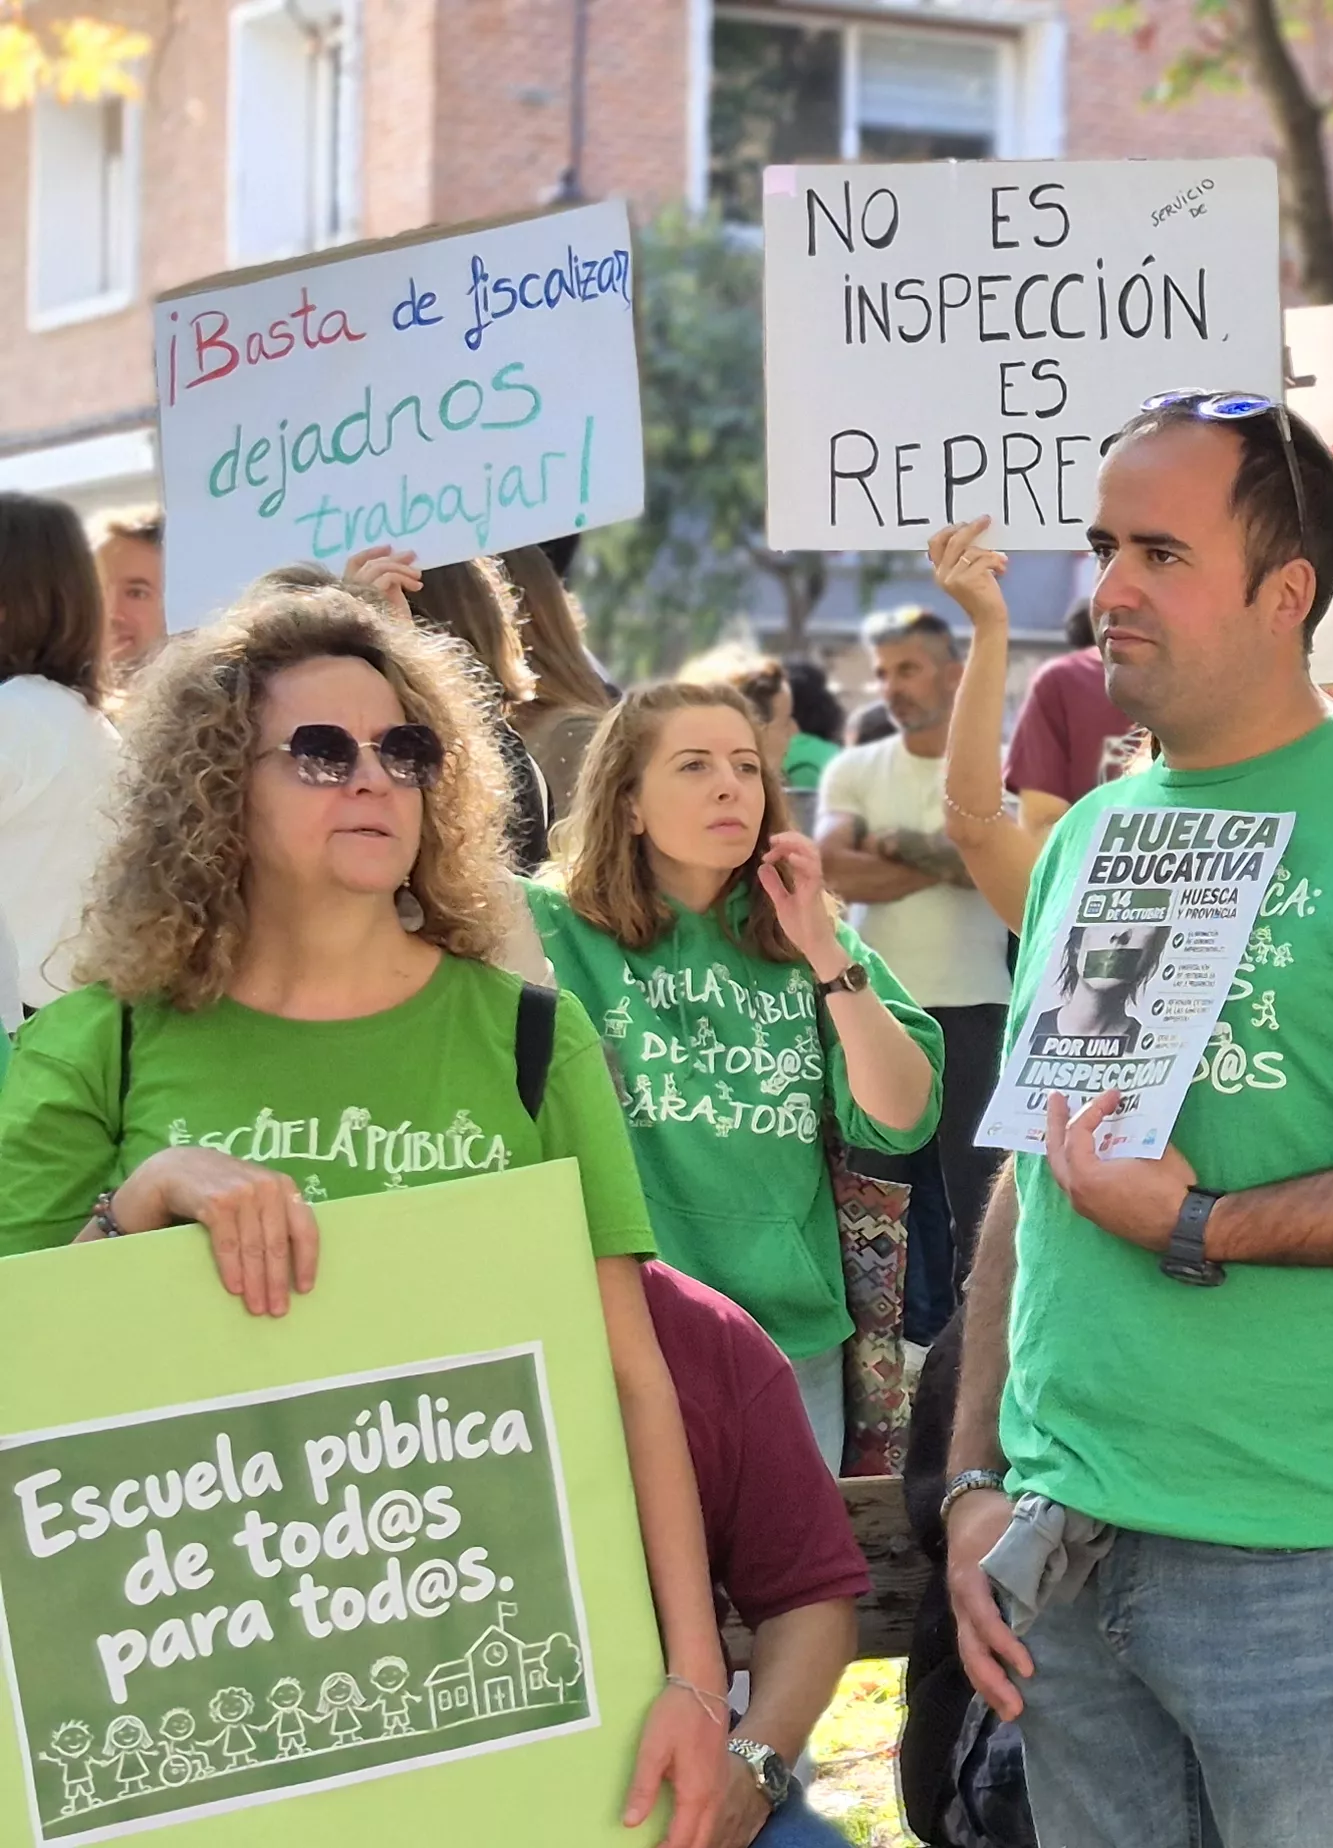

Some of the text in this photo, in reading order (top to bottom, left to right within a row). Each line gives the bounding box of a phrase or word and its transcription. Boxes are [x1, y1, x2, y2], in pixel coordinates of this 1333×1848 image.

[805, 180, 1071, 257] NO ES
[1150, 178, 1215, 228] SERVICIO
[168, 244, 631, 408] ¡Basta de fiscalizar
[999, 356, 1068, 420] ES
[208, 360, 544, 519] dejadnos
[829, 428, 1118, 528] REPRE
[1098, 811, 1281, 852] HUELGA
[1087, 851, 1266, 885] EDUCATIVA
[1106, 908, 1121, 921] DE
[1111, 890, 1132, 908] 14
[1177, 906, 1238, 920] Y PROVINCIA
[1180, 887, 1239, 906] HUESCA
[699, 1046, 824, 1081] TOD@S
[1042, 1037, 1120, 1058] POR UNA
[1024, 1058, 1172, 1091] INSPECCIÓN
[13, 1393, 534, 1558] Escuela pública
[123, 1483, 463, 1608] de tod@s
[96, 1546, 515, 1705] para tod@s.
